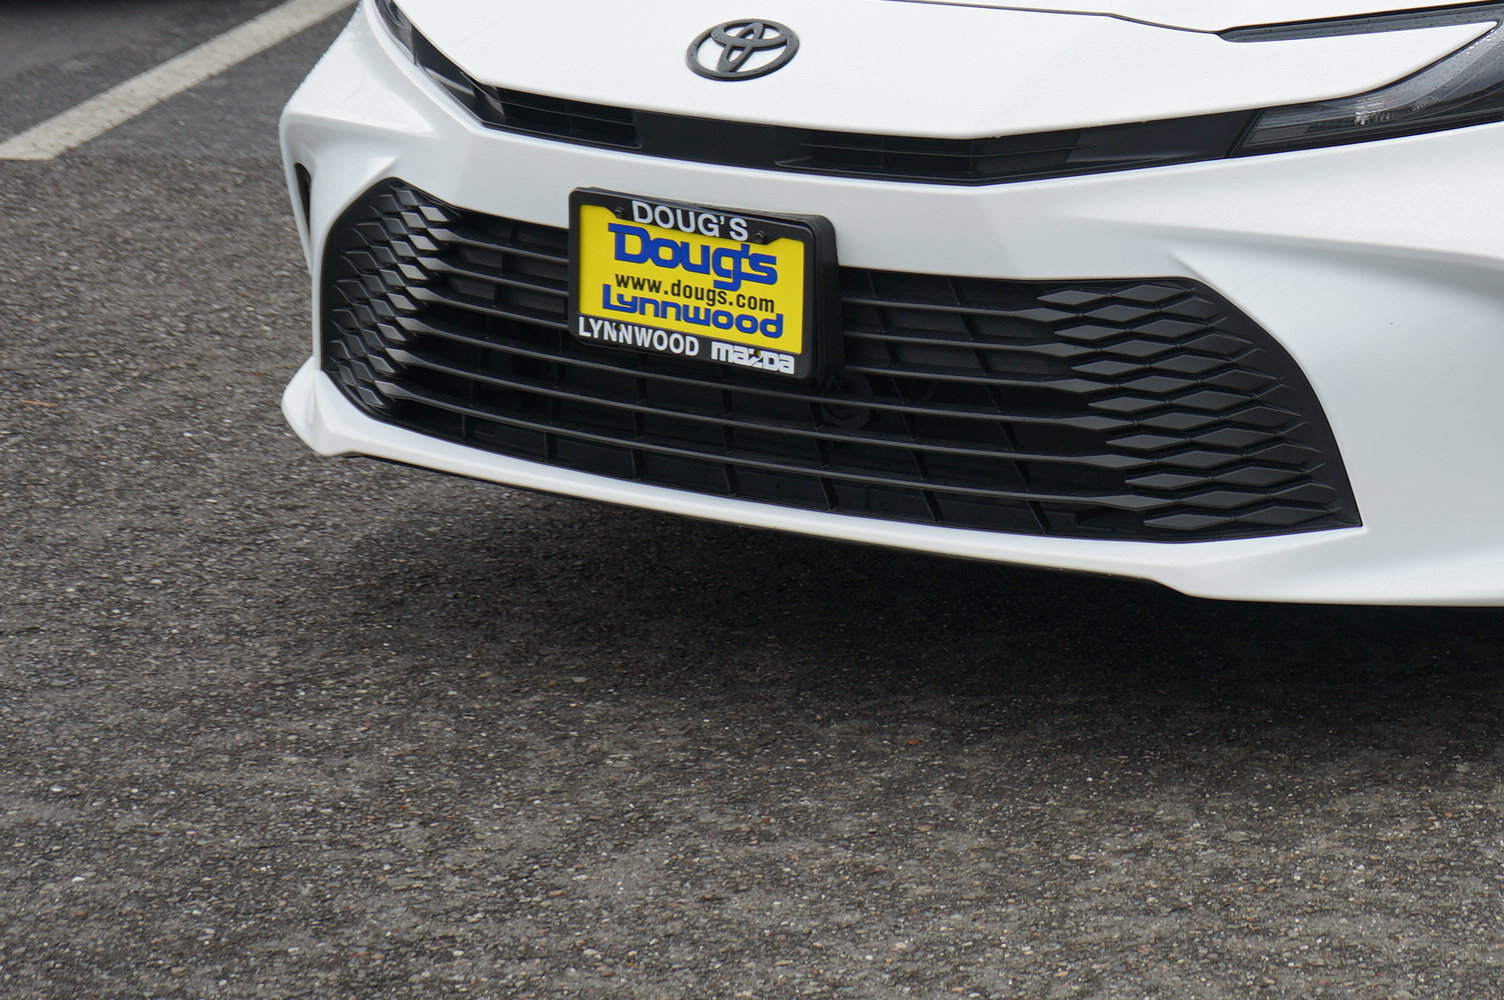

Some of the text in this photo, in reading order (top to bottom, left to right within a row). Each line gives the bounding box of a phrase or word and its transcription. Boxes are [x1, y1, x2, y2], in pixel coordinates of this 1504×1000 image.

[632, 200, 749, 242] DOUG'S
[602, 283, 784, 339] Lynnwood
[615, 273, 775, 313] www.dougs.com
[578, 316, 699, 356] LYNNWOOD
